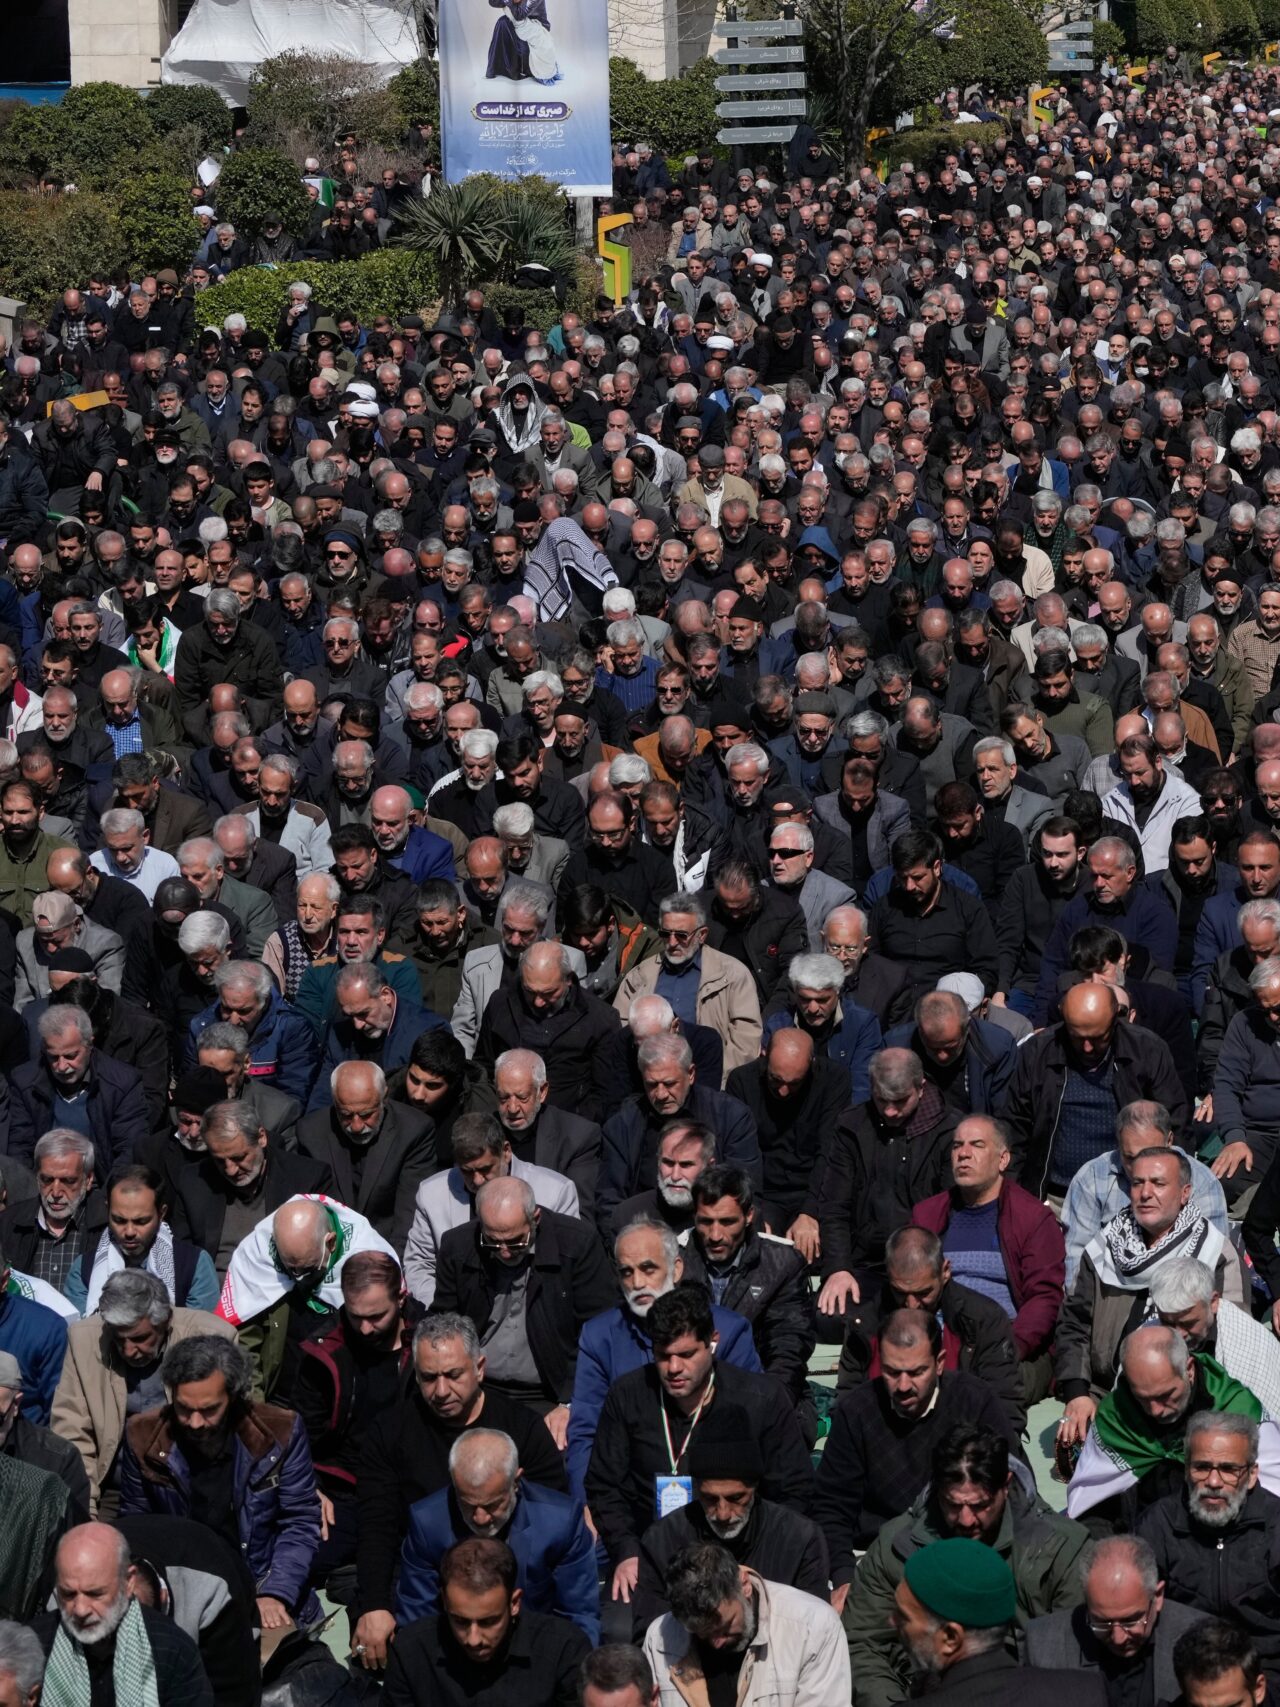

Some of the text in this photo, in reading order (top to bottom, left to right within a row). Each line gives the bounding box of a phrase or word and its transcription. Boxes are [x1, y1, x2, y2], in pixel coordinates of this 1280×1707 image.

[480, 104, 563, 118] صبری که از خداست
